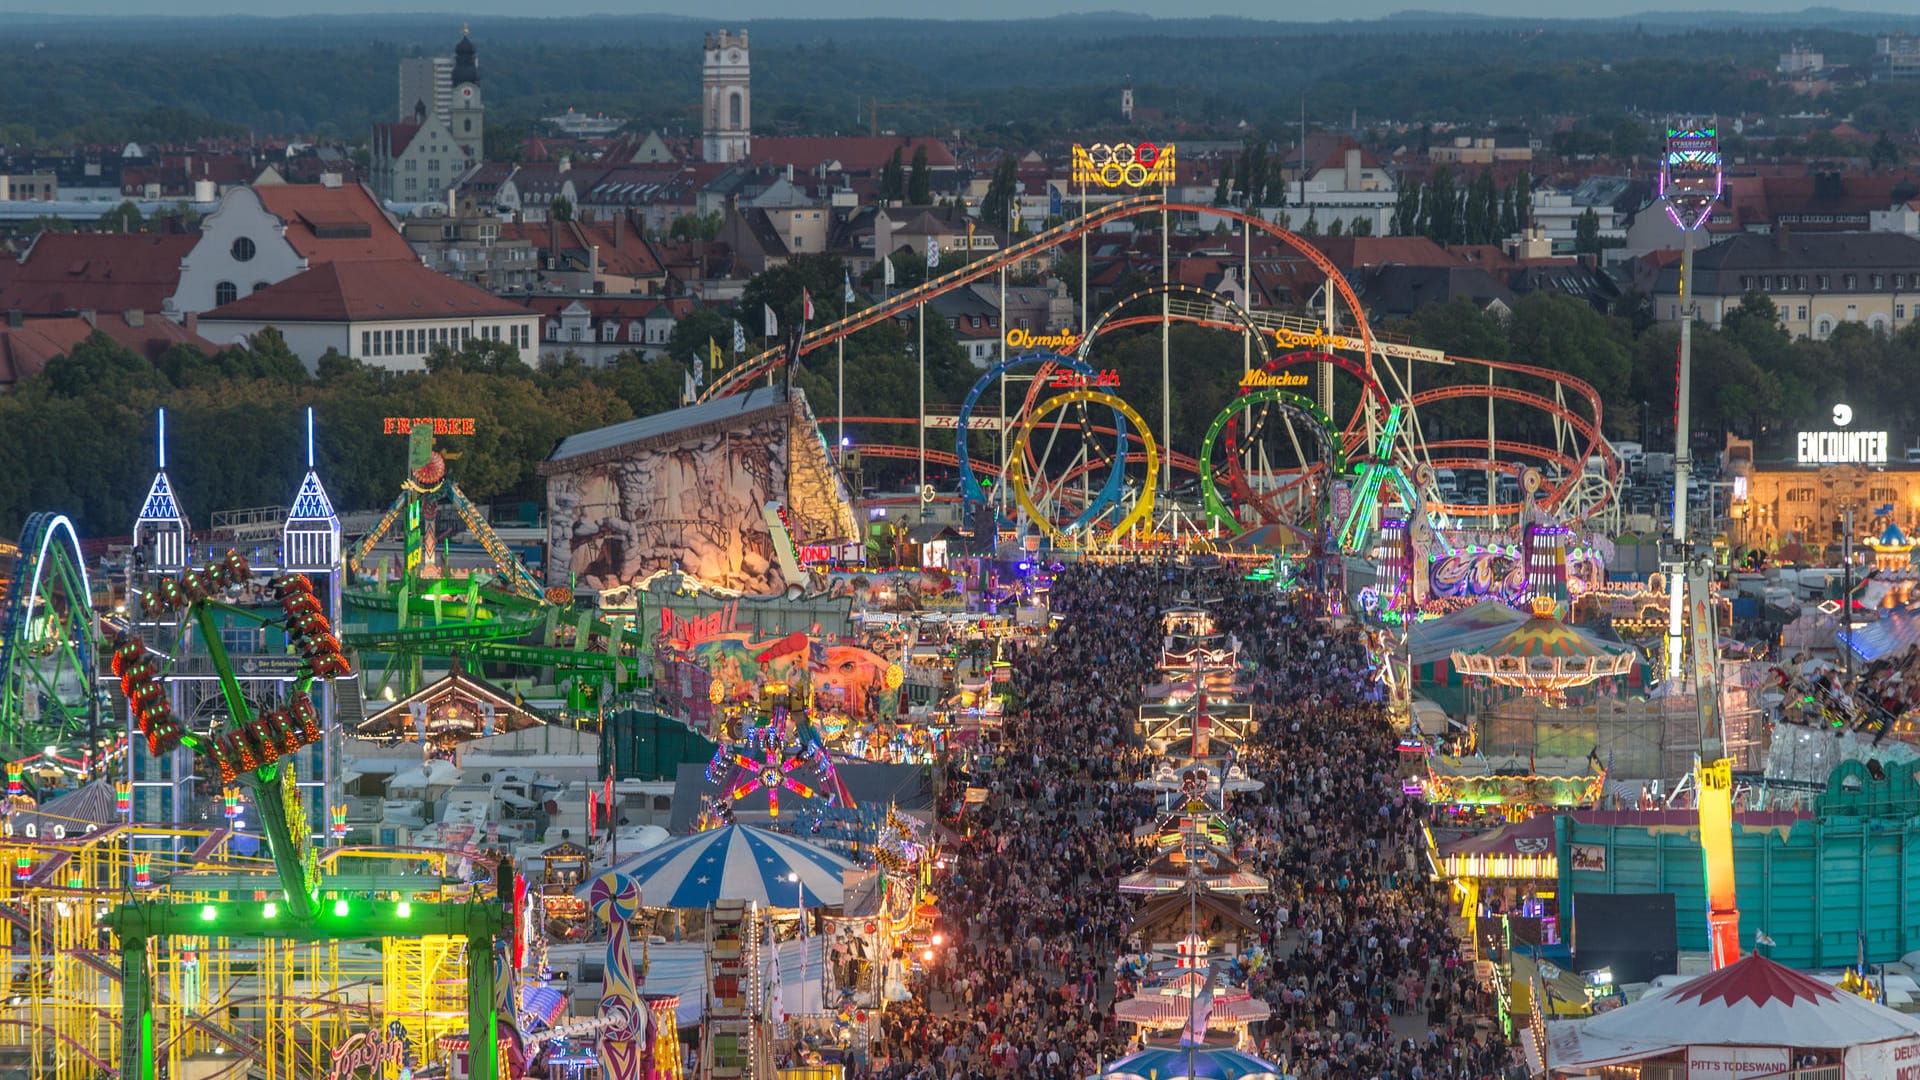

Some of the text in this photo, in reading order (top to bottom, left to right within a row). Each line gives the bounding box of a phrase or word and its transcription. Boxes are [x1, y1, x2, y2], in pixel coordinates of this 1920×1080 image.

[1006, 328, 1077, 349] Olympia
[1275, 328, 1346, 349] Looping
[1049, 369, 1121, 388] Bath
[1238, 368, 1309, 387] München
[930, 416, 995, 429] Bath
[1797, 431, 1888, 463] ENCOUNTER
[661, 600, 738, 650] Playball
[1690, 1060, 1787, 1073] PITT'S TODESWAND
